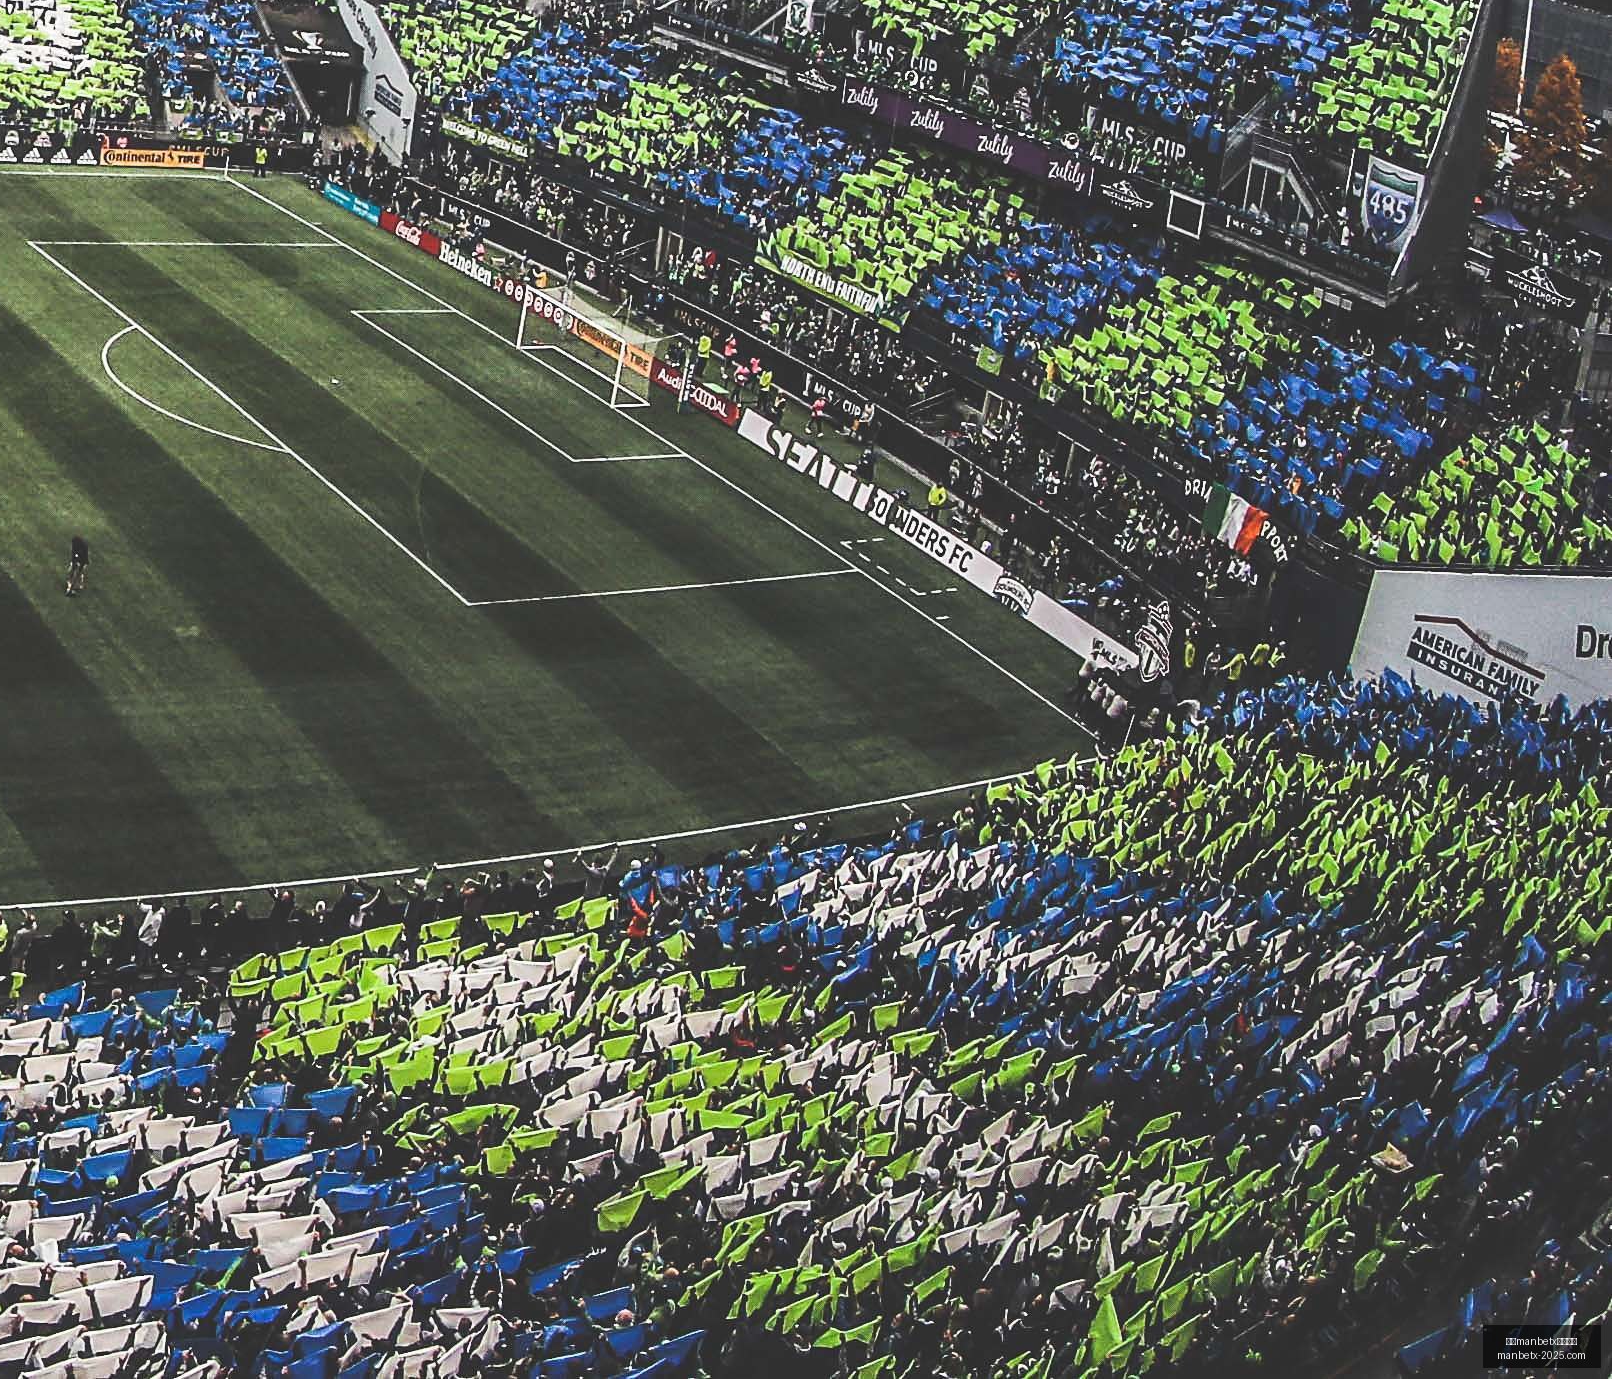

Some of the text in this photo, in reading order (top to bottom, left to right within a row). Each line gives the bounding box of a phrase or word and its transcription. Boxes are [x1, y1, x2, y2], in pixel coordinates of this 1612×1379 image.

[477, 130, 487, 143] TO
[487, 135, 511, 151] GREEN
[104, 150, 166, 164] Continental
[177, 155, 200, 164] TIRE
[1369, 190, 1407, 224] 485
[439, 241, 492, 286] Heineken
[780, 254, 834, 296] NORTH END
[630, 351, 649, 369] TIRE
[657, 368, 684, 390] Audi
[949, 548, 973, 573] FC
[1412, 626, 1540, 700] AMERICAN FAMILY
